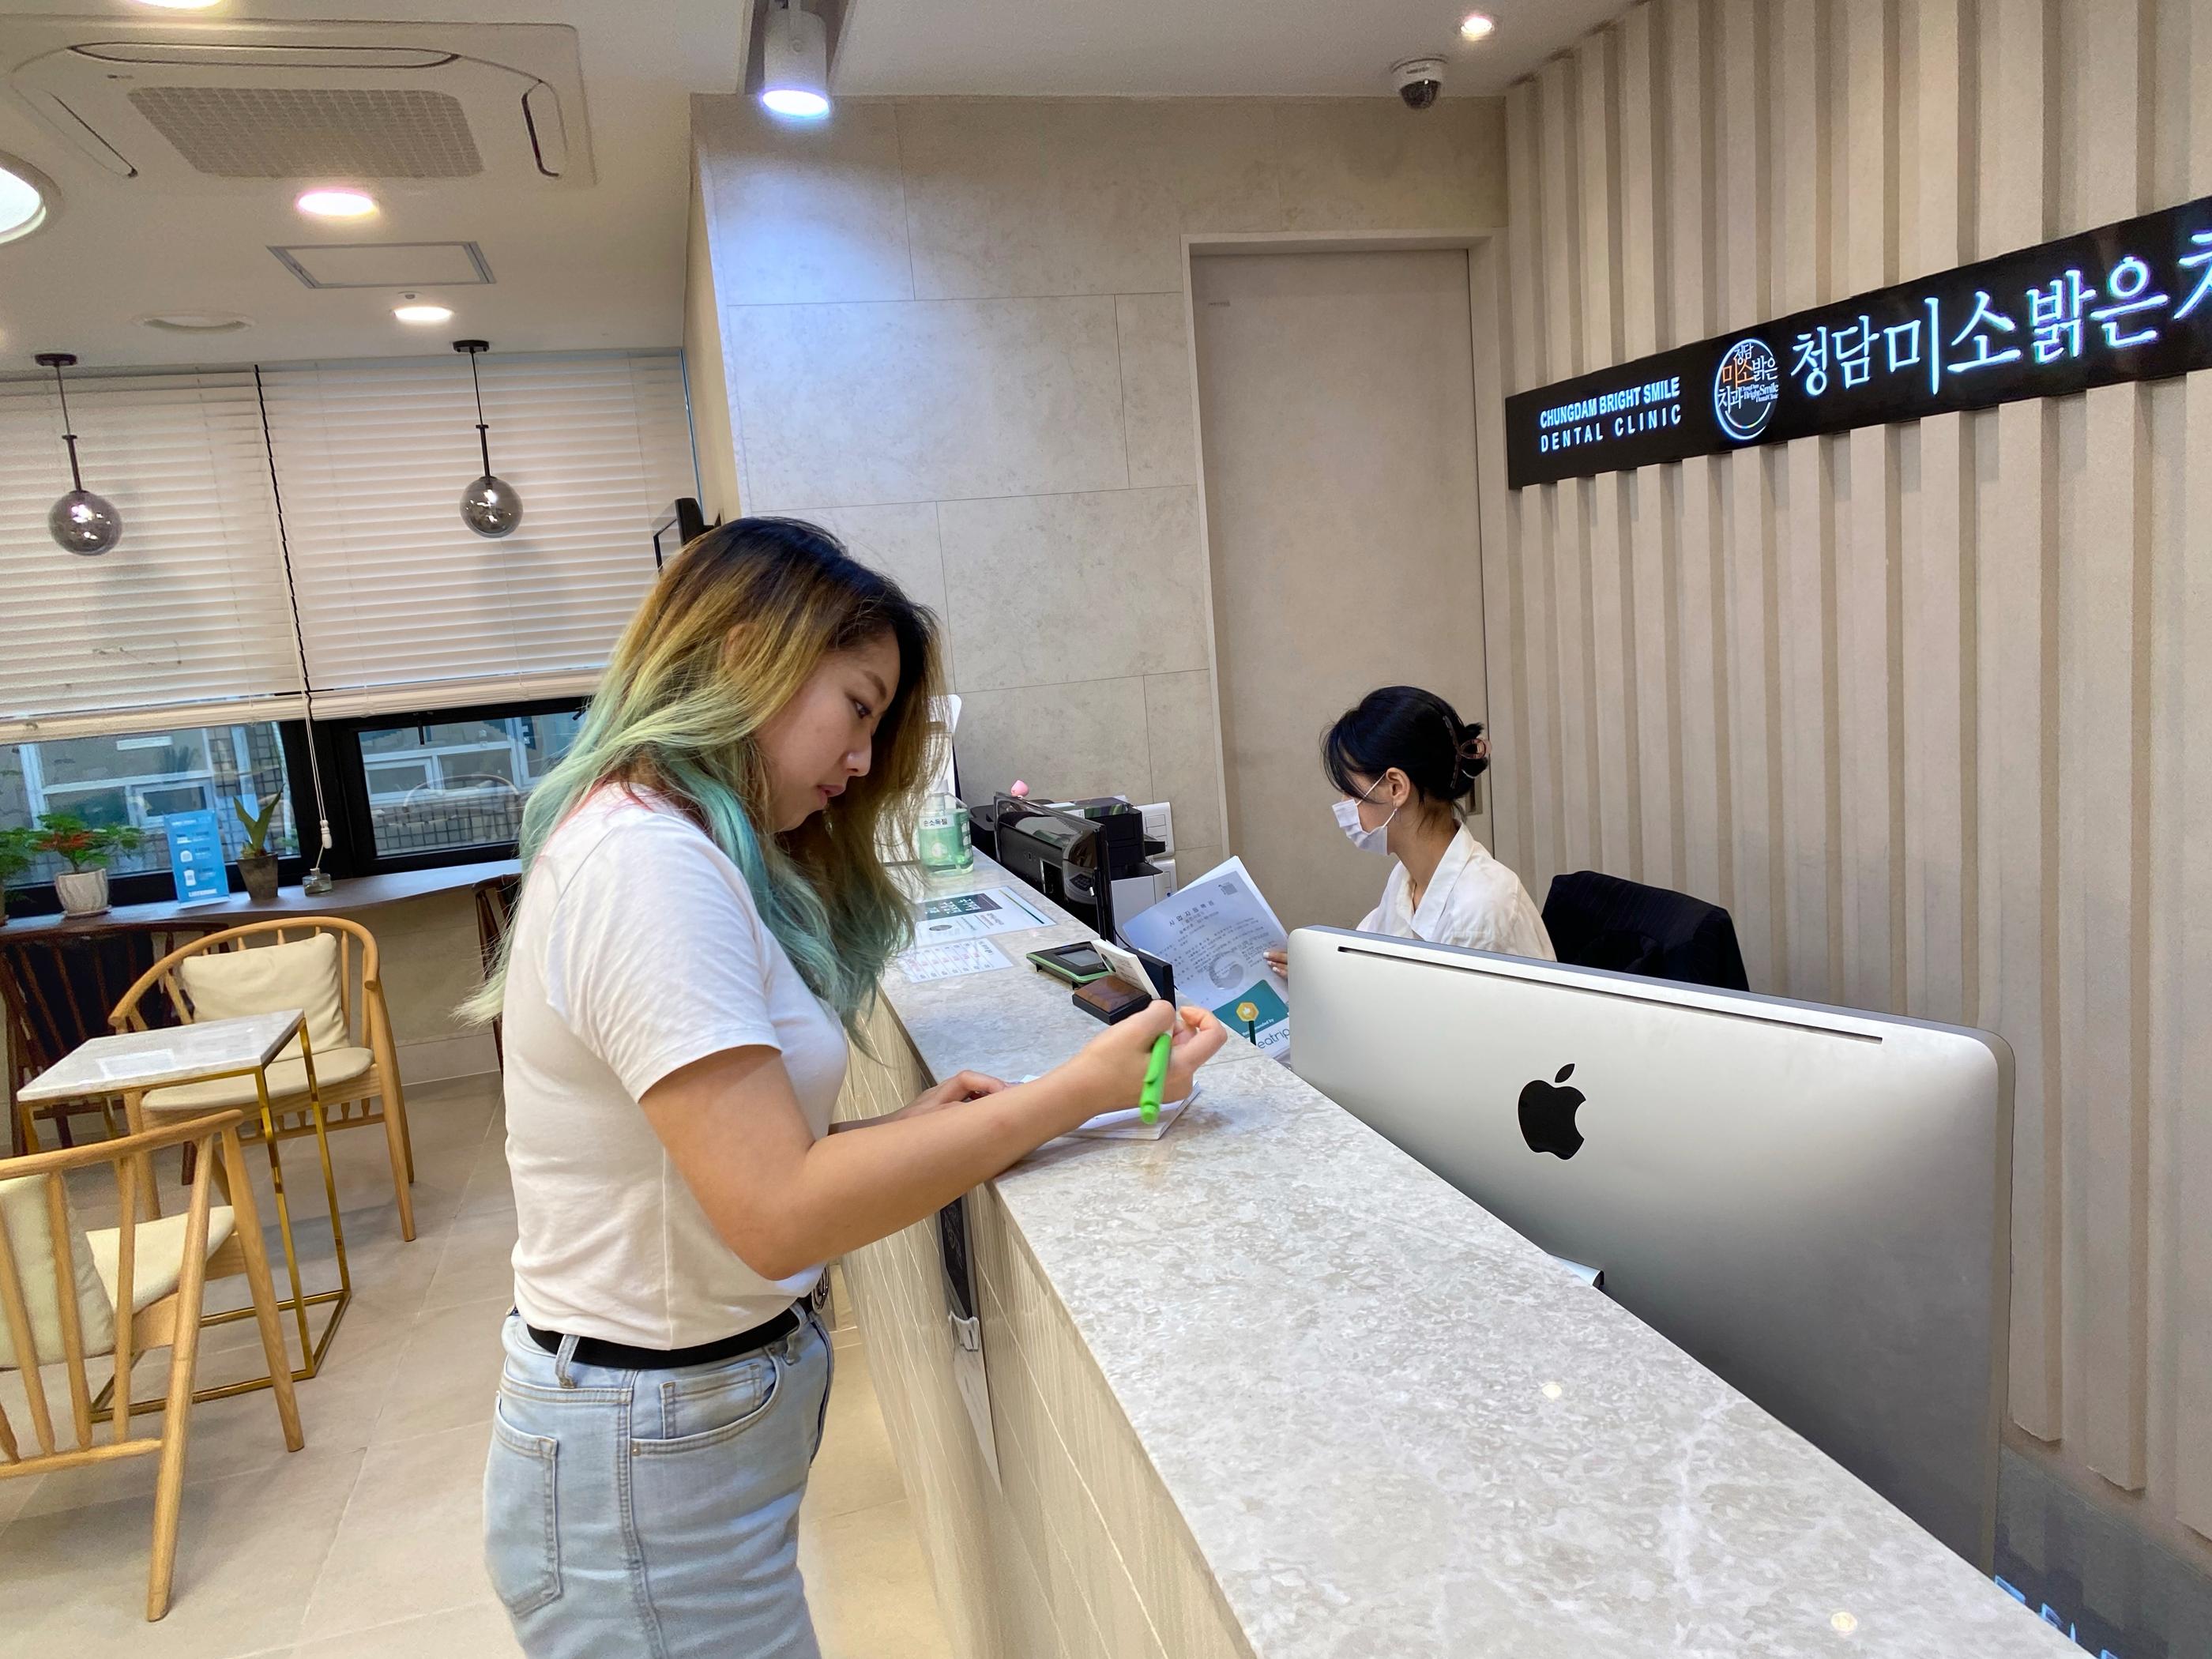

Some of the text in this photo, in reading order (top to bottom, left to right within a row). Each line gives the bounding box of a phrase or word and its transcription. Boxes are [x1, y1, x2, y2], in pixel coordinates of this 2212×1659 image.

[1734, 343, 1754, 365] 청담
[1718, 386, 1743, 414] 치과
[1759, 382, 1778, 396] Smile
[1540, 376, 1680, 428] CHUNGDAM BRIGHT SMILE
[1540, 404, 1681, 453] DENTAL CLINIC
[1257, 1029, 1289, 1049] eatrip
